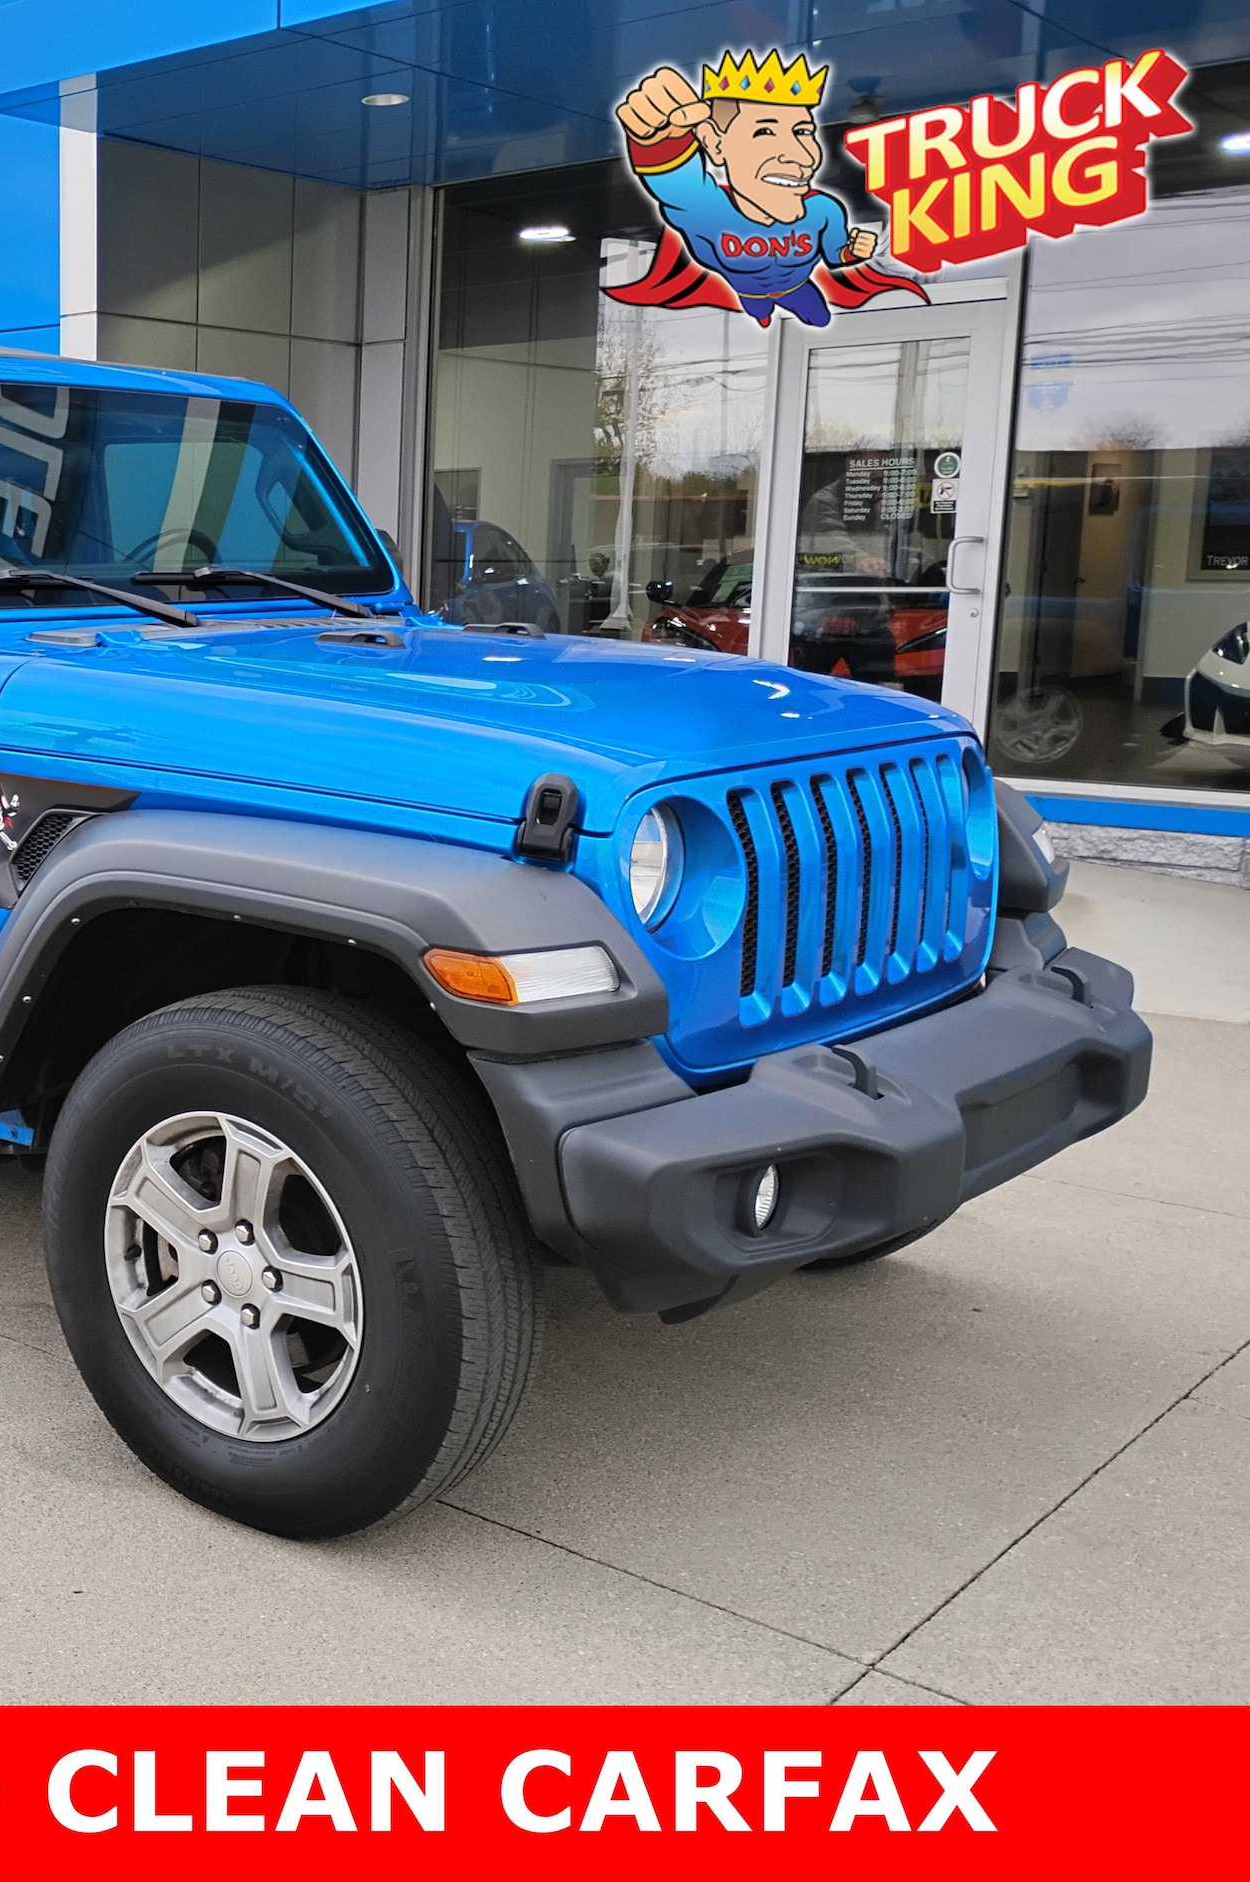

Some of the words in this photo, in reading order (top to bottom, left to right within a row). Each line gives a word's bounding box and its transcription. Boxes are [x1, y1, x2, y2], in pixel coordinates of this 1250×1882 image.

[849, 459, 879, 468] SALES
[881, 457, 915, 467] HOURS
[880, 512, 913, 520] CLOSED
